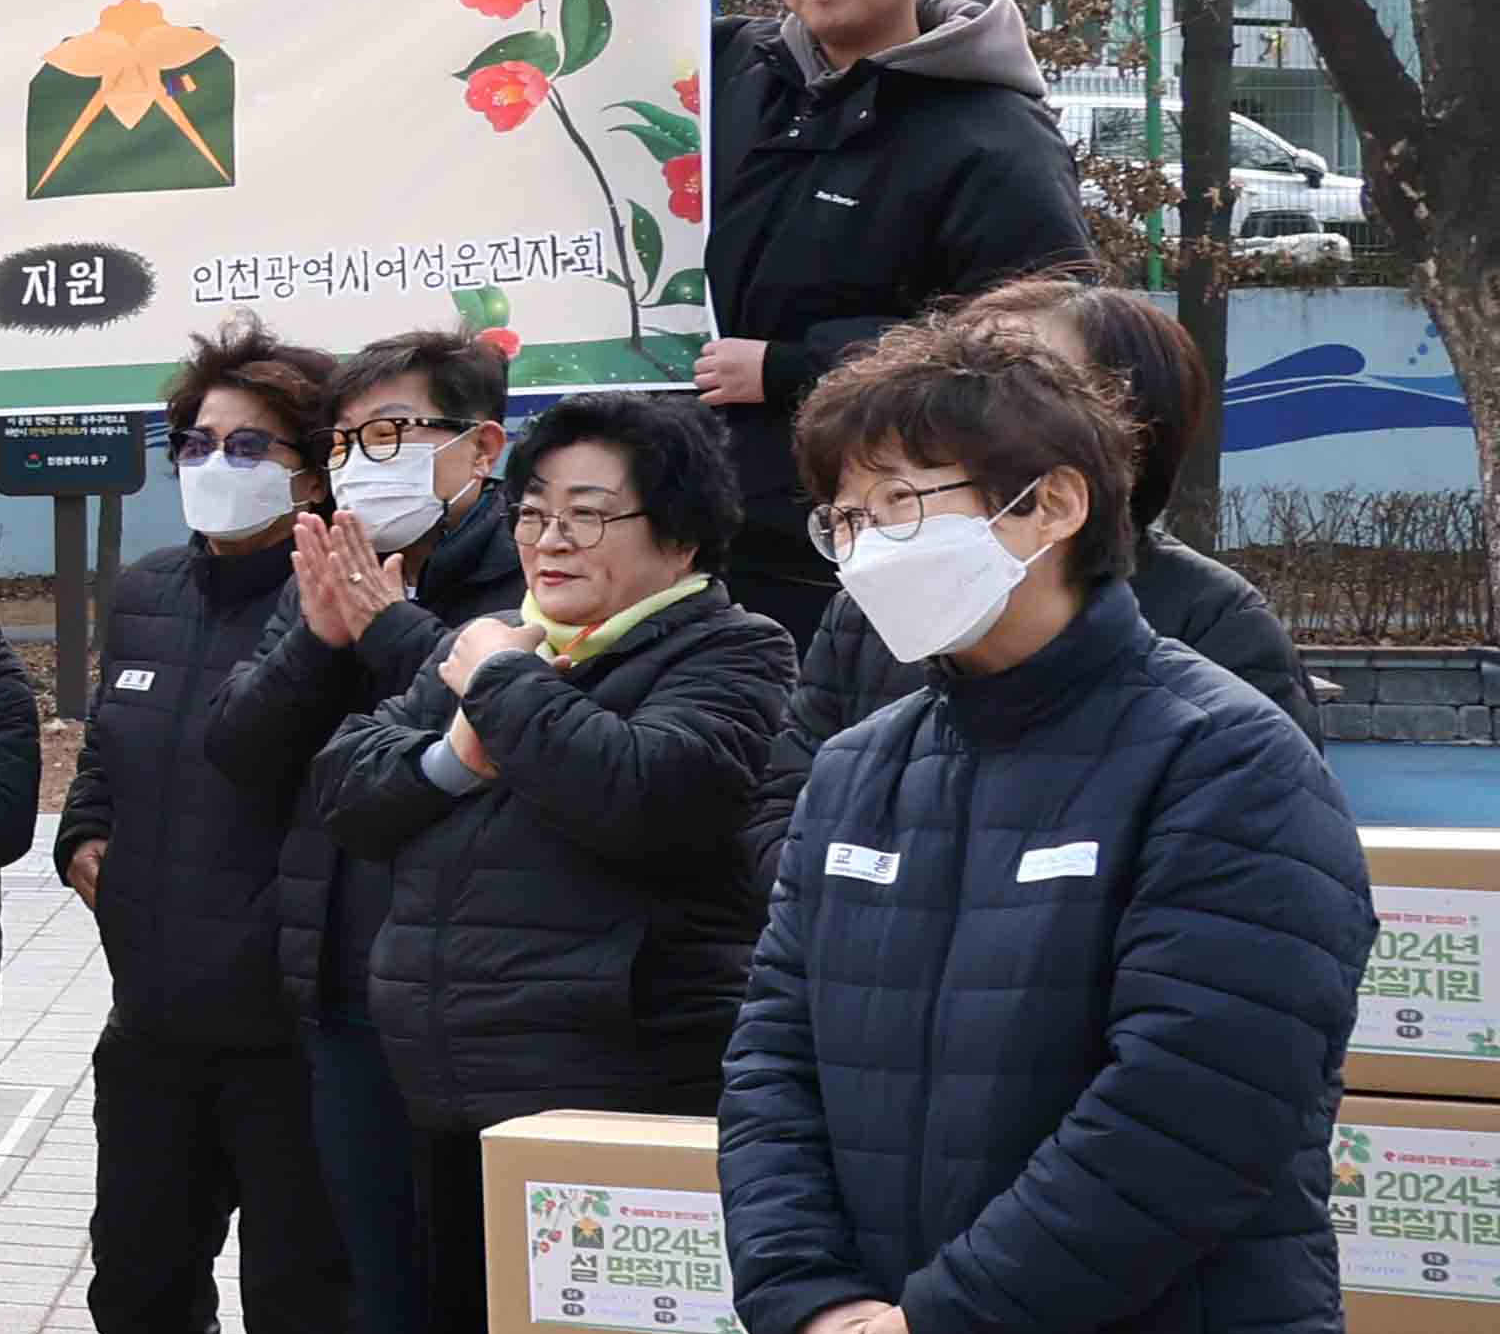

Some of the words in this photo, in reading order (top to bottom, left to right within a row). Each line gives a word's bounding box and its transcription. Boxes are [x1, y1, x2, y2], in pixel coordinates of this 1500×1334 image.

[20, 257, 107, 307] 지원
[191, 231, 608, 304] 인천광역시여성운전자회
[1375, 1170, 1500, 1209] 2024년
[612, 1224, 721, 1259] 2024년
[1368, 1206, 1500, 1246] 명절지원
[571, 1253, 599, 1283] 설
[607, 1256, 720, 1292] 명절지원
